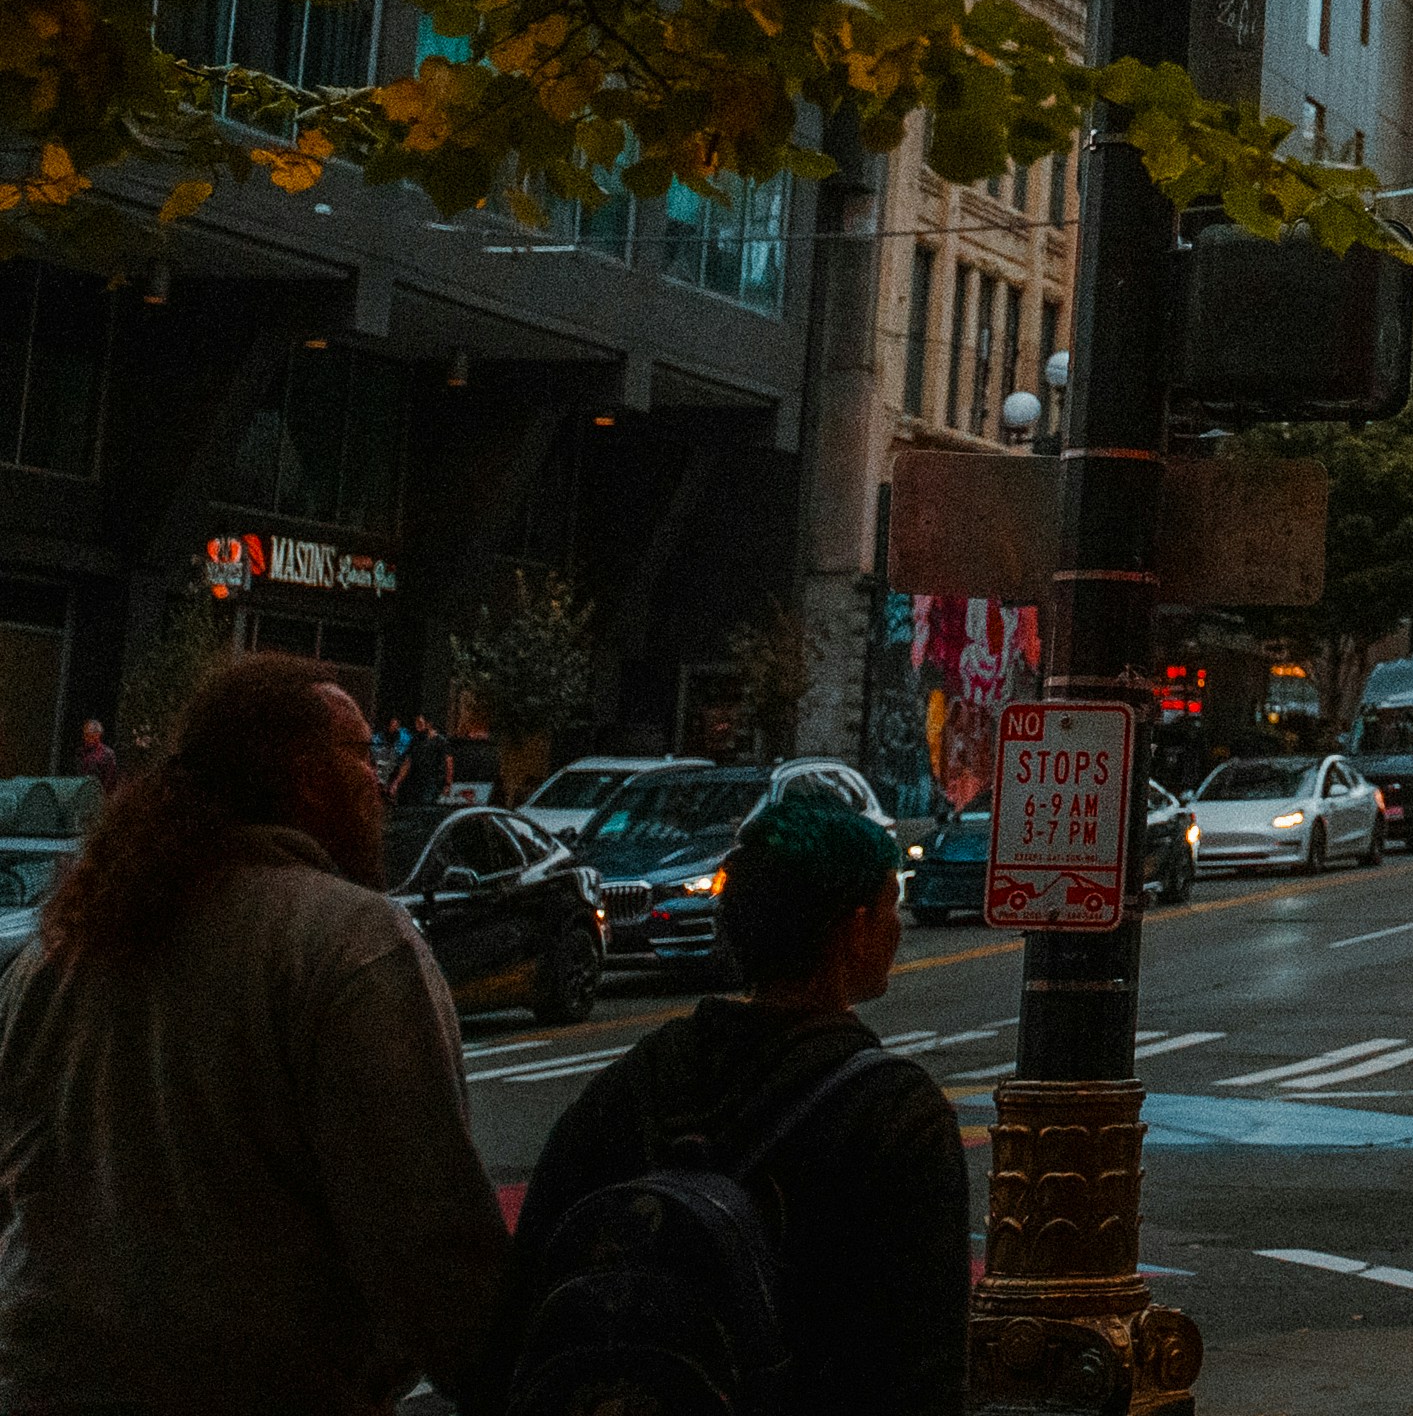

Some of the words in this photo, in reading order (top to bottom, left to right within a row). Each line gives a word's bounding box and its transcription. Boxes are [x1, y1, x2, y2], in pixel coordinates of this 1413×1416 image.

[1008, 711, 1041, 736] NO
[1016, 749, 1109, 786] STOPS
[1024, 794, 1062, 817] 6-9
[1069, 794, 1098, 818] AM
[1022, 820, 1058, 845] 3-7
[1069, 820, 1097, 846] PM
